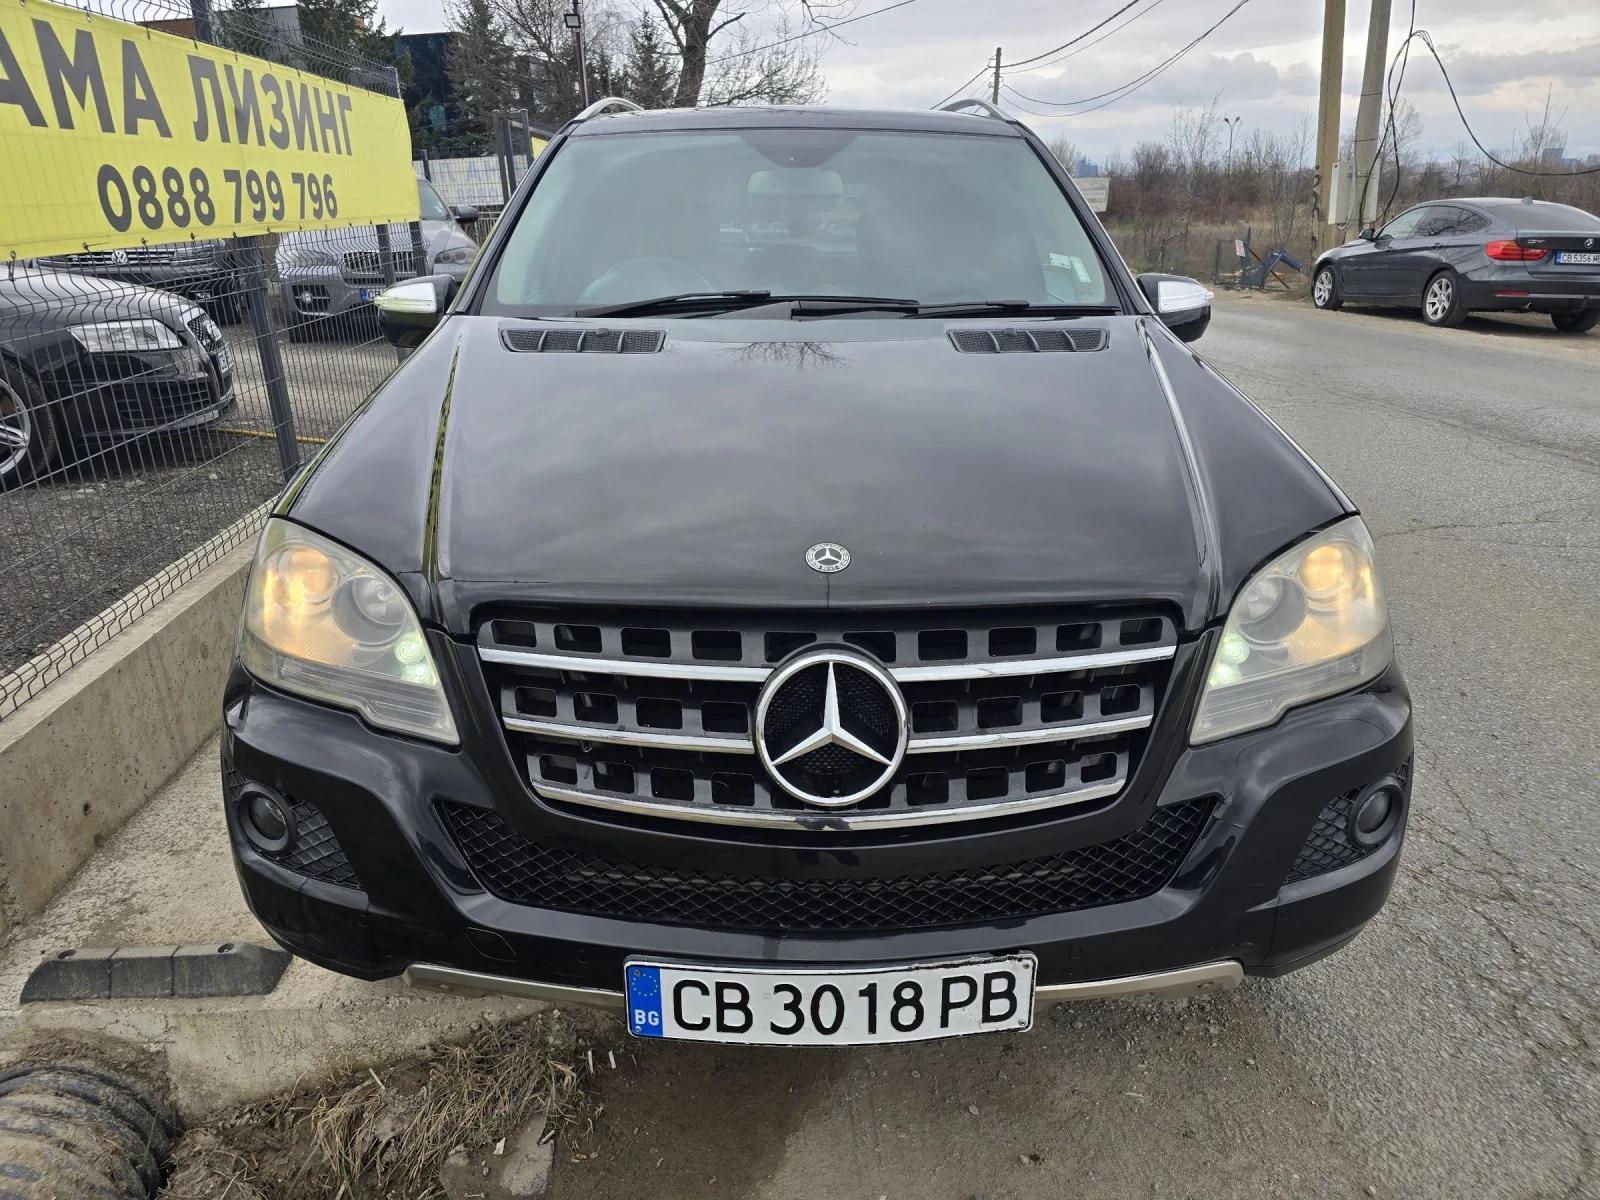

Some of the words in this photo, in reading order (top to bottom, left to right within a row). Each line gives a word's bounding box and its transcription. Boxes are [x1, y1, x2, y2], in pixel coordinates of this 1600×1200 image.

[186, 54, 354, 157] ЛИЗИНГ
[97, 163, 217, 233] 0888
[223, 169, 286, 224] 799
[291, 172, 339, 221] 796
[634, 1009, 660, 1026] BG
[672, 979, 754, 1035] CB
[769, 980, 925, 1036] 3018
[939, 970, 1018, 1029] PB
